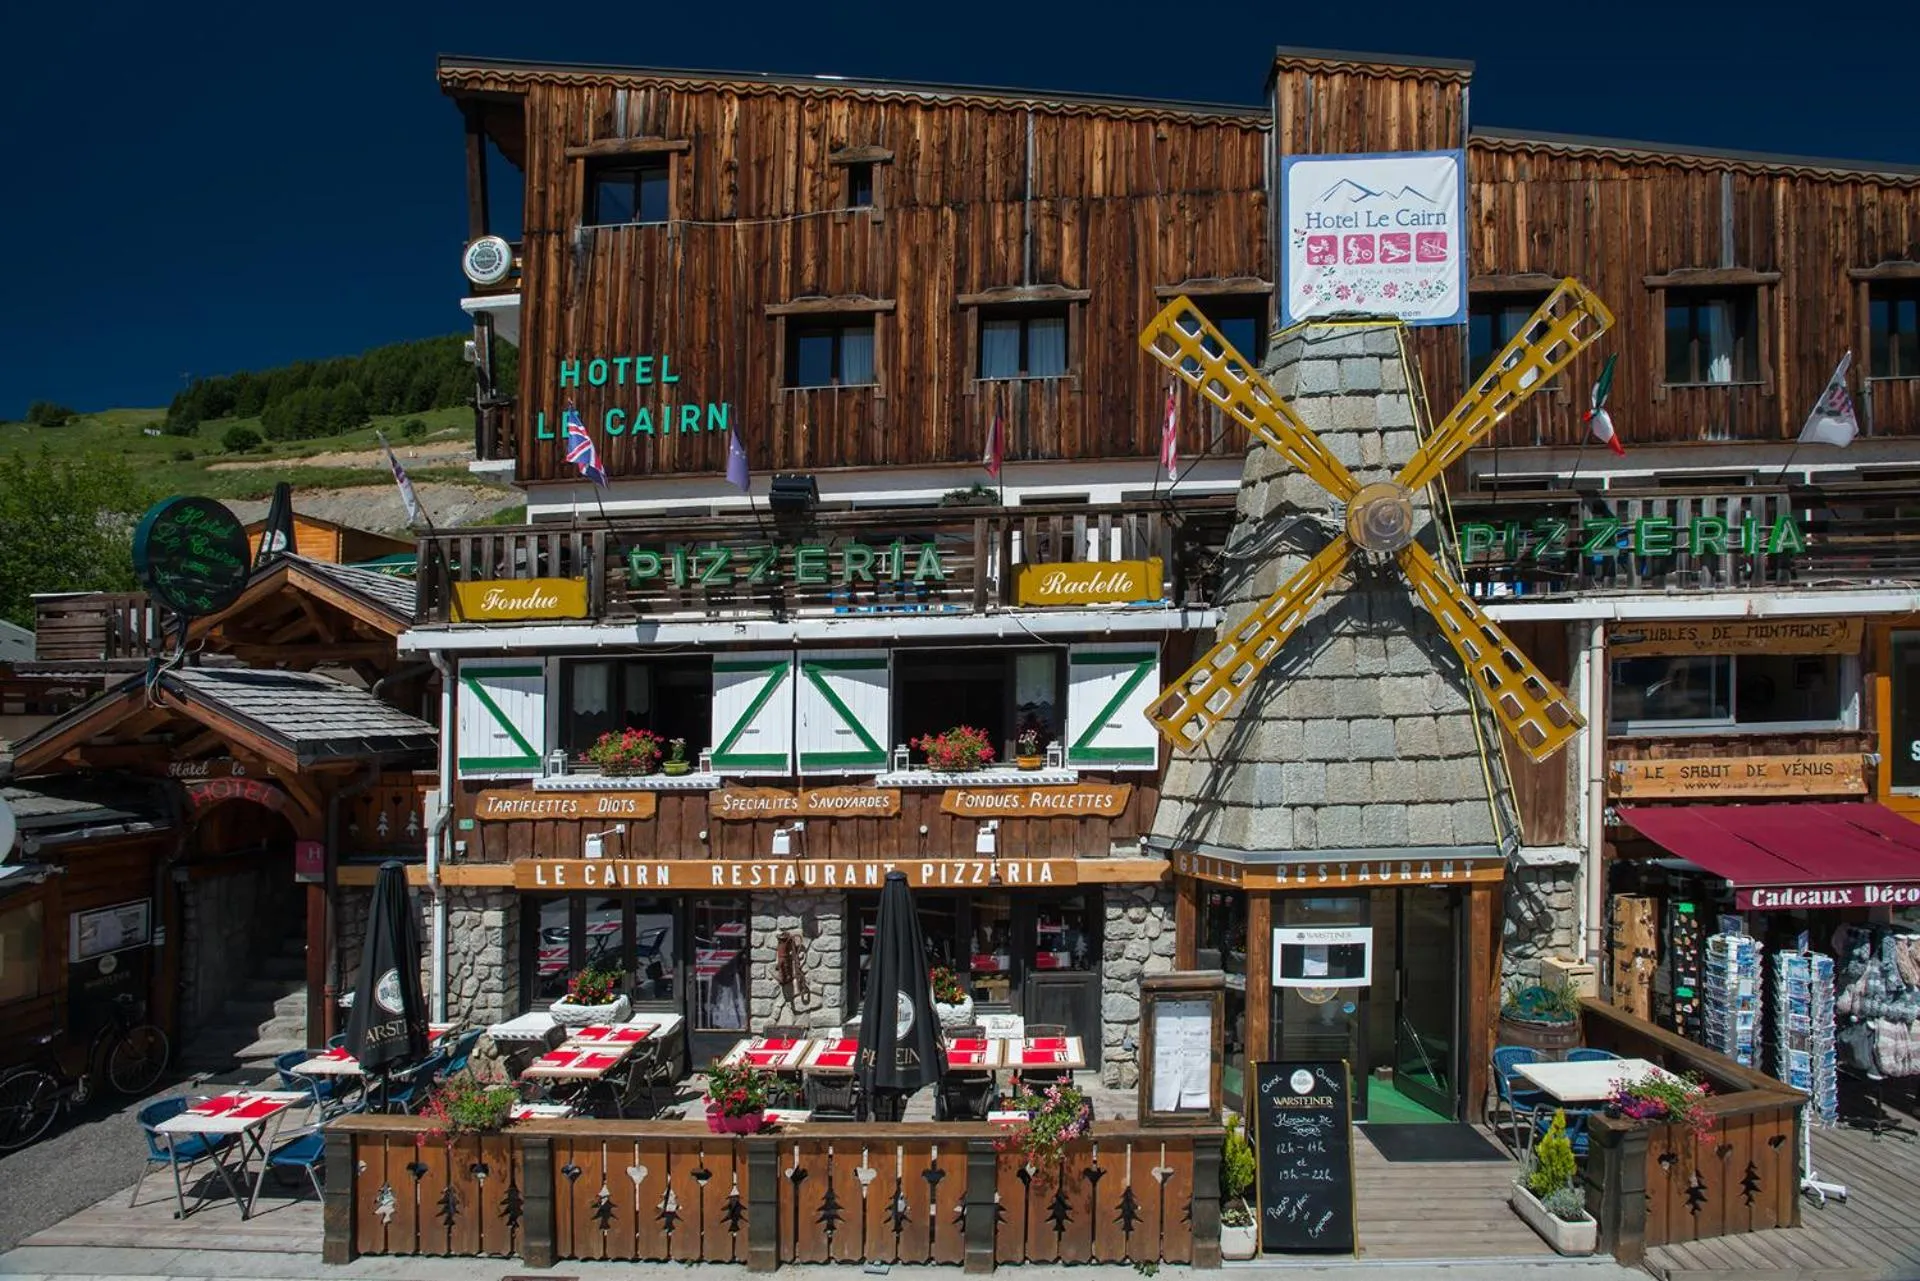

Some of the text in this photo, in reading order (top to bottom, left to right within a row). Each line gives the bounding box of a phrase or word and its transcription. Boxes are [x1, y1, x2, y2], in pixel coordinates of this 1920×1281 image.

[1305, 208, 1447, 229] Hotel Le Cairn
[560, 355, 680, 388] HOTEL
[605, 402, 730, 437] CAIRN
[1461, 514, 1806, 564] PIZZERIA
[627, 543, 946, 587] PIZZERIA
[1038, 570, 1134, 595] Raclette
[480, 586, 558, 612] Fondue
[1712, 625, 1732, 640] DE
[1746, 624, 1831, 640] MONTAGNE
[1644, 759, 1834, 779] LE SABOT DE VÉNUS
[808, 792, 890, 809] SAVOYARDES
[1030, 791, 1113, 808] RACLETTES
[535, 864, 566, 886] LE
[584, 863, 670, 886] CAIRN
[1179, 854, 1475, 884] GRILL RESTAURANT
[1752, 887, 1852, 908] Cadeaux
[1273, 1096, 1334, 1106] WARSTEINER
[1276, 1142, 1295, 1155] 12h
[1312, 1169, 1334, 1182] 22h
